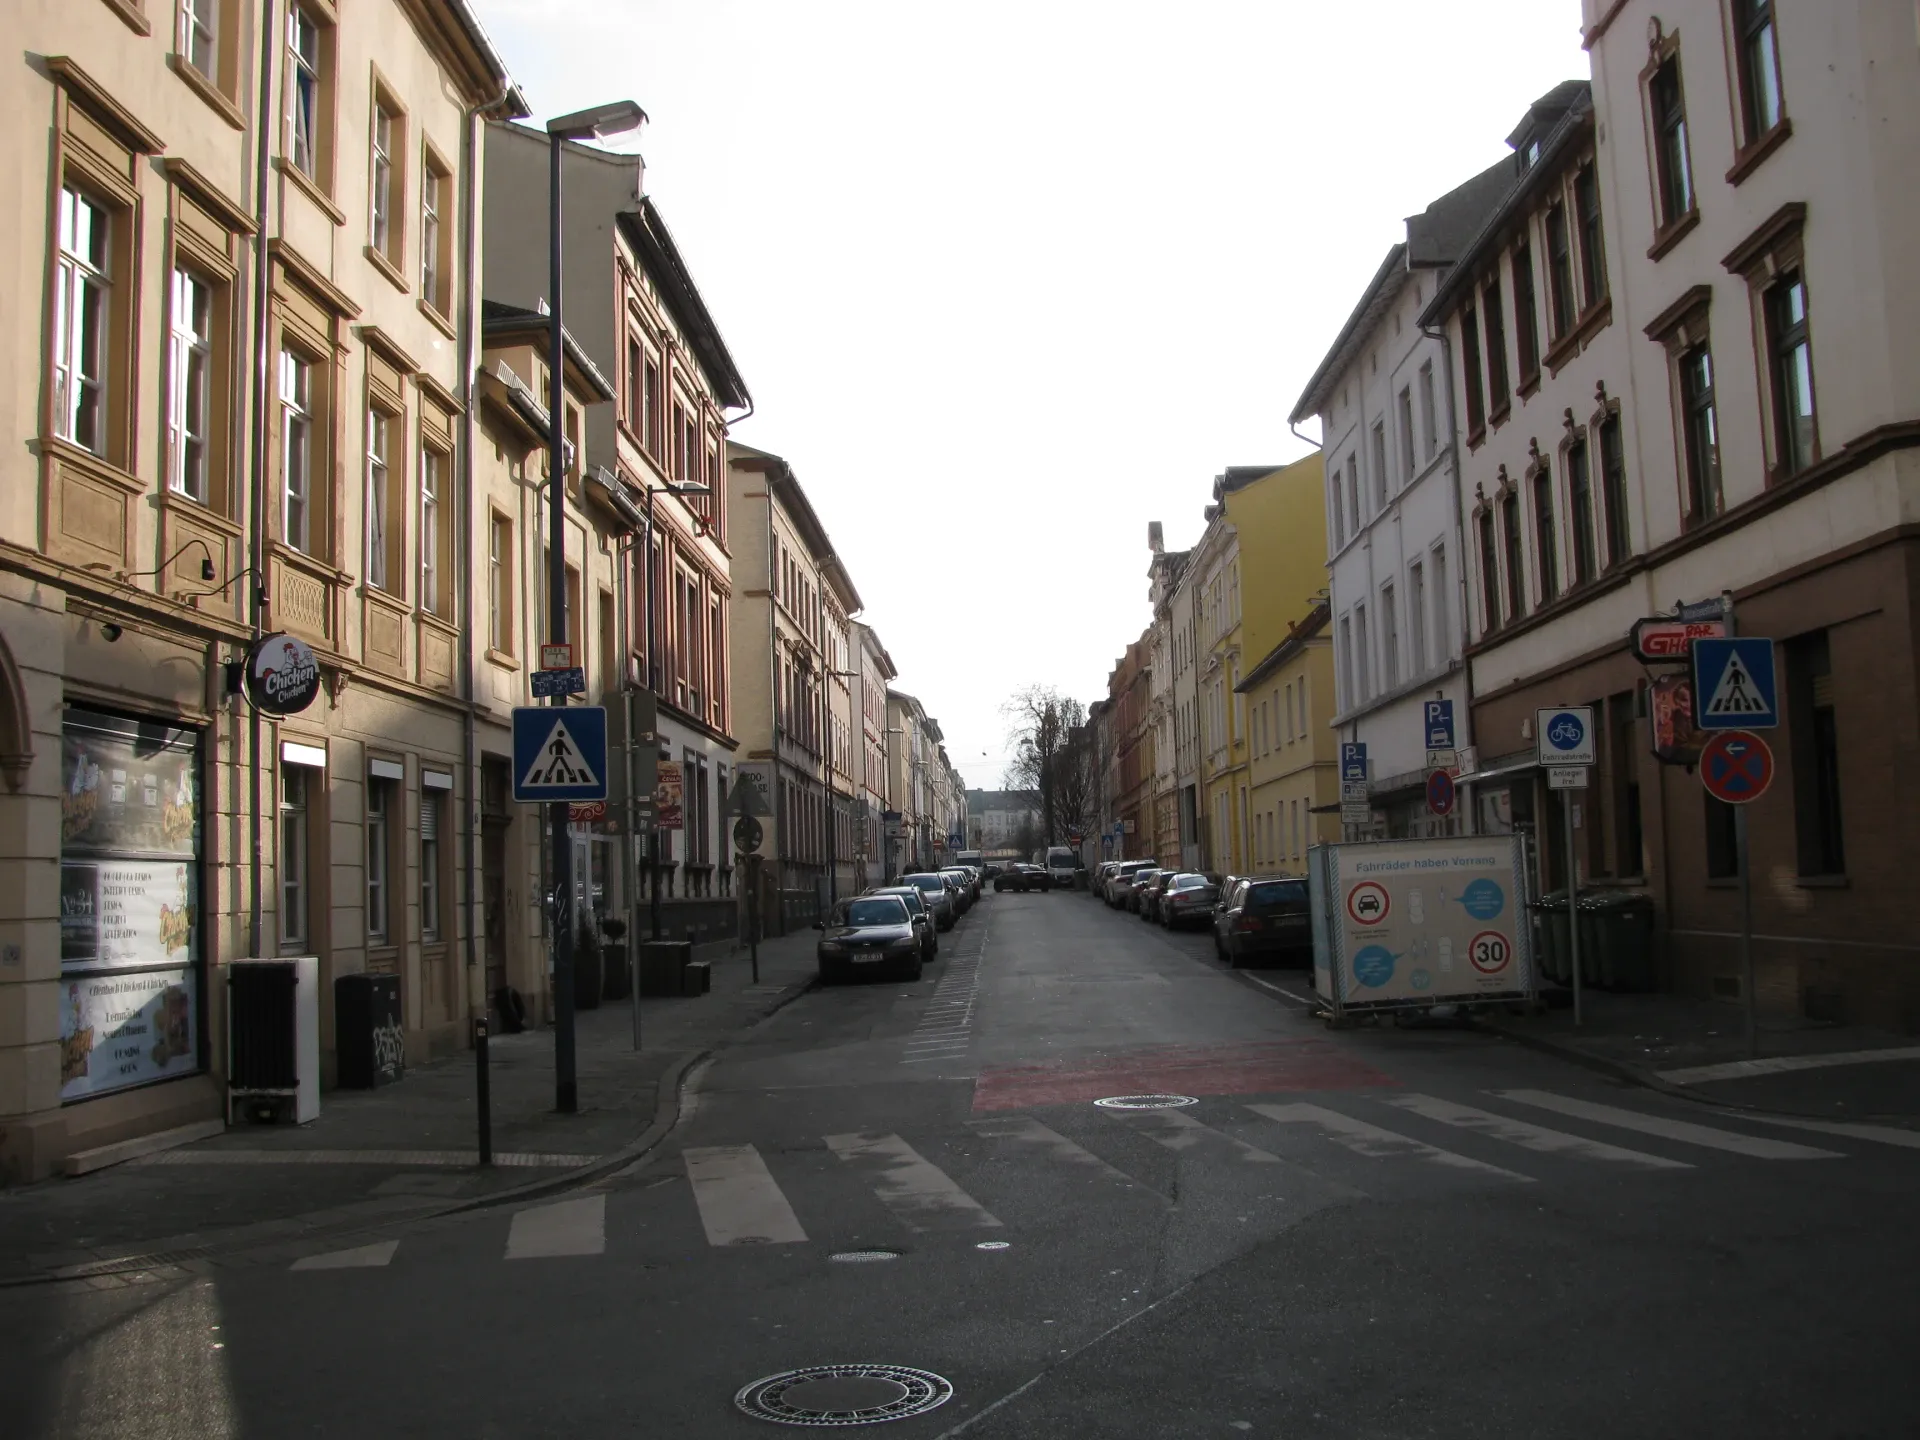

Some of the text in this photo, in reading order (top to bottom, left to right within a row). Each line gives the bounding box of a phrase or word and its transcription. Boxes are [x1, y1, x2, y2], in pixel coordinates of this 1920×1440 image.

[1685, 624, 1715, 637] BAR
[265, 665, 314, 695] Chicken
[278, 684, 307, 703] Chicken
[1429, 703, 1441, 723] P
[1345, 745, 1356, 761] P
[1542, 752, 1592, 761] Fahrradstraße
[1552, 770, 1584, 778] Anlieger
[1356, 855, 1496, 873] Fahrräder haben Vorrang
[1477, 941, 1503, 962] 30
[120, 980, 142, 993] Chicken
[147, 979, 169, 990] Chicken
